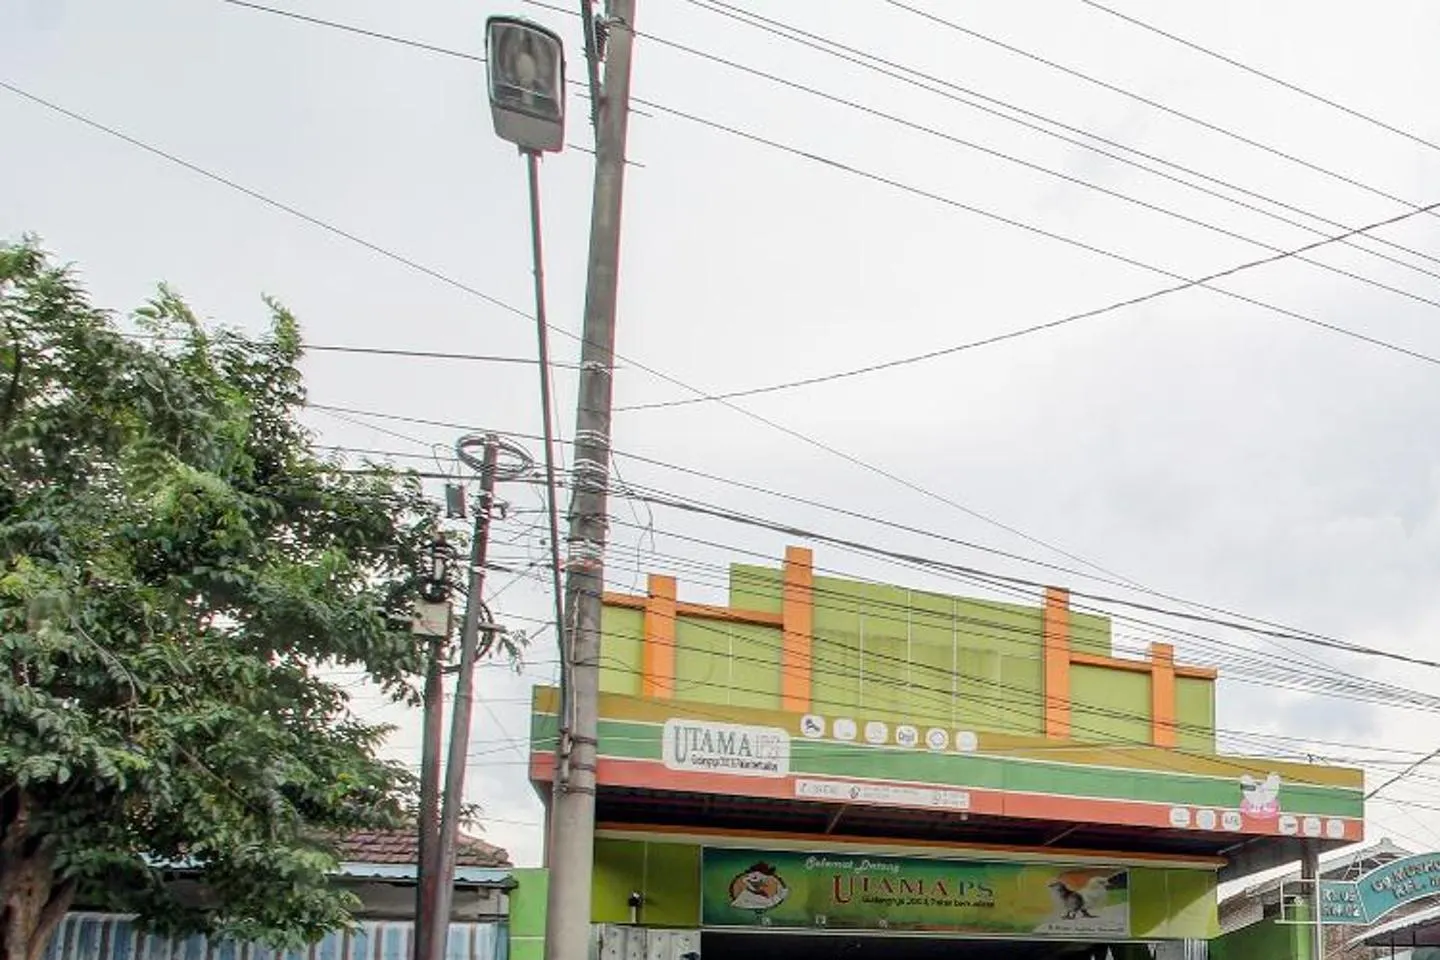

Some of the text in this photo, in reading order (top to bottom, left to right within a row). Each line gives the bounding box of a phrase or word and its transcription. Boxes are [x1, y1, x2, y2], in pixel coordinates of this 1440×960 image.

[673, 725, 753, 763] UTAMA
[804, 856, 854, 870] Selamat
[833, 874, 994, 905] UTAMA PS
